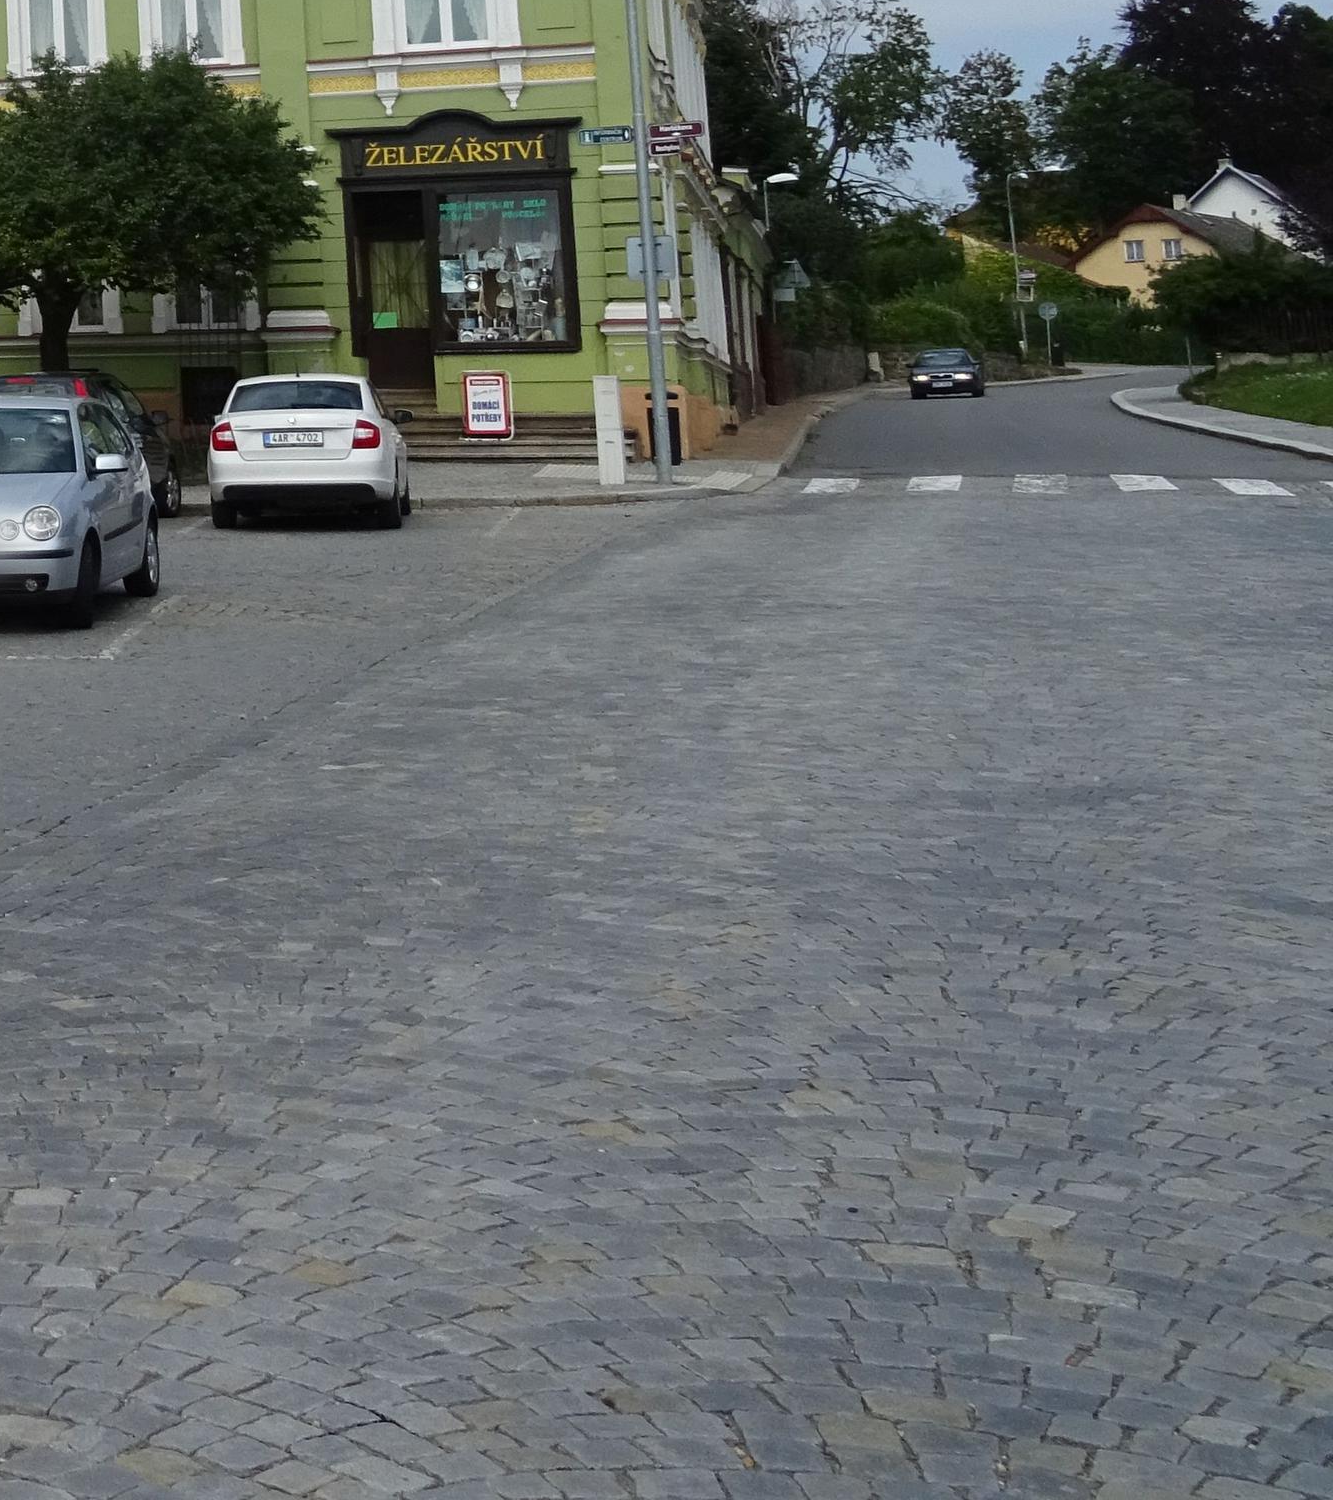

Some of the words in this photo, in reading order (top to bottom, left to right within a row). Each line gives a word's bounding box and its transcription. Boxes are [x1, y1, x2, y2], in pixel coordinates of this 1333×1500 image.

[365, 133, 545, 167] ŽELEZÁŘSTVÍ
[472, 400, 500, 410] DOMÁCÍ
[471, 412, 502, 422] POTŘEBY
[272, 434, 289, 442] 4AR
[296, 433, 319, 442] 4702
